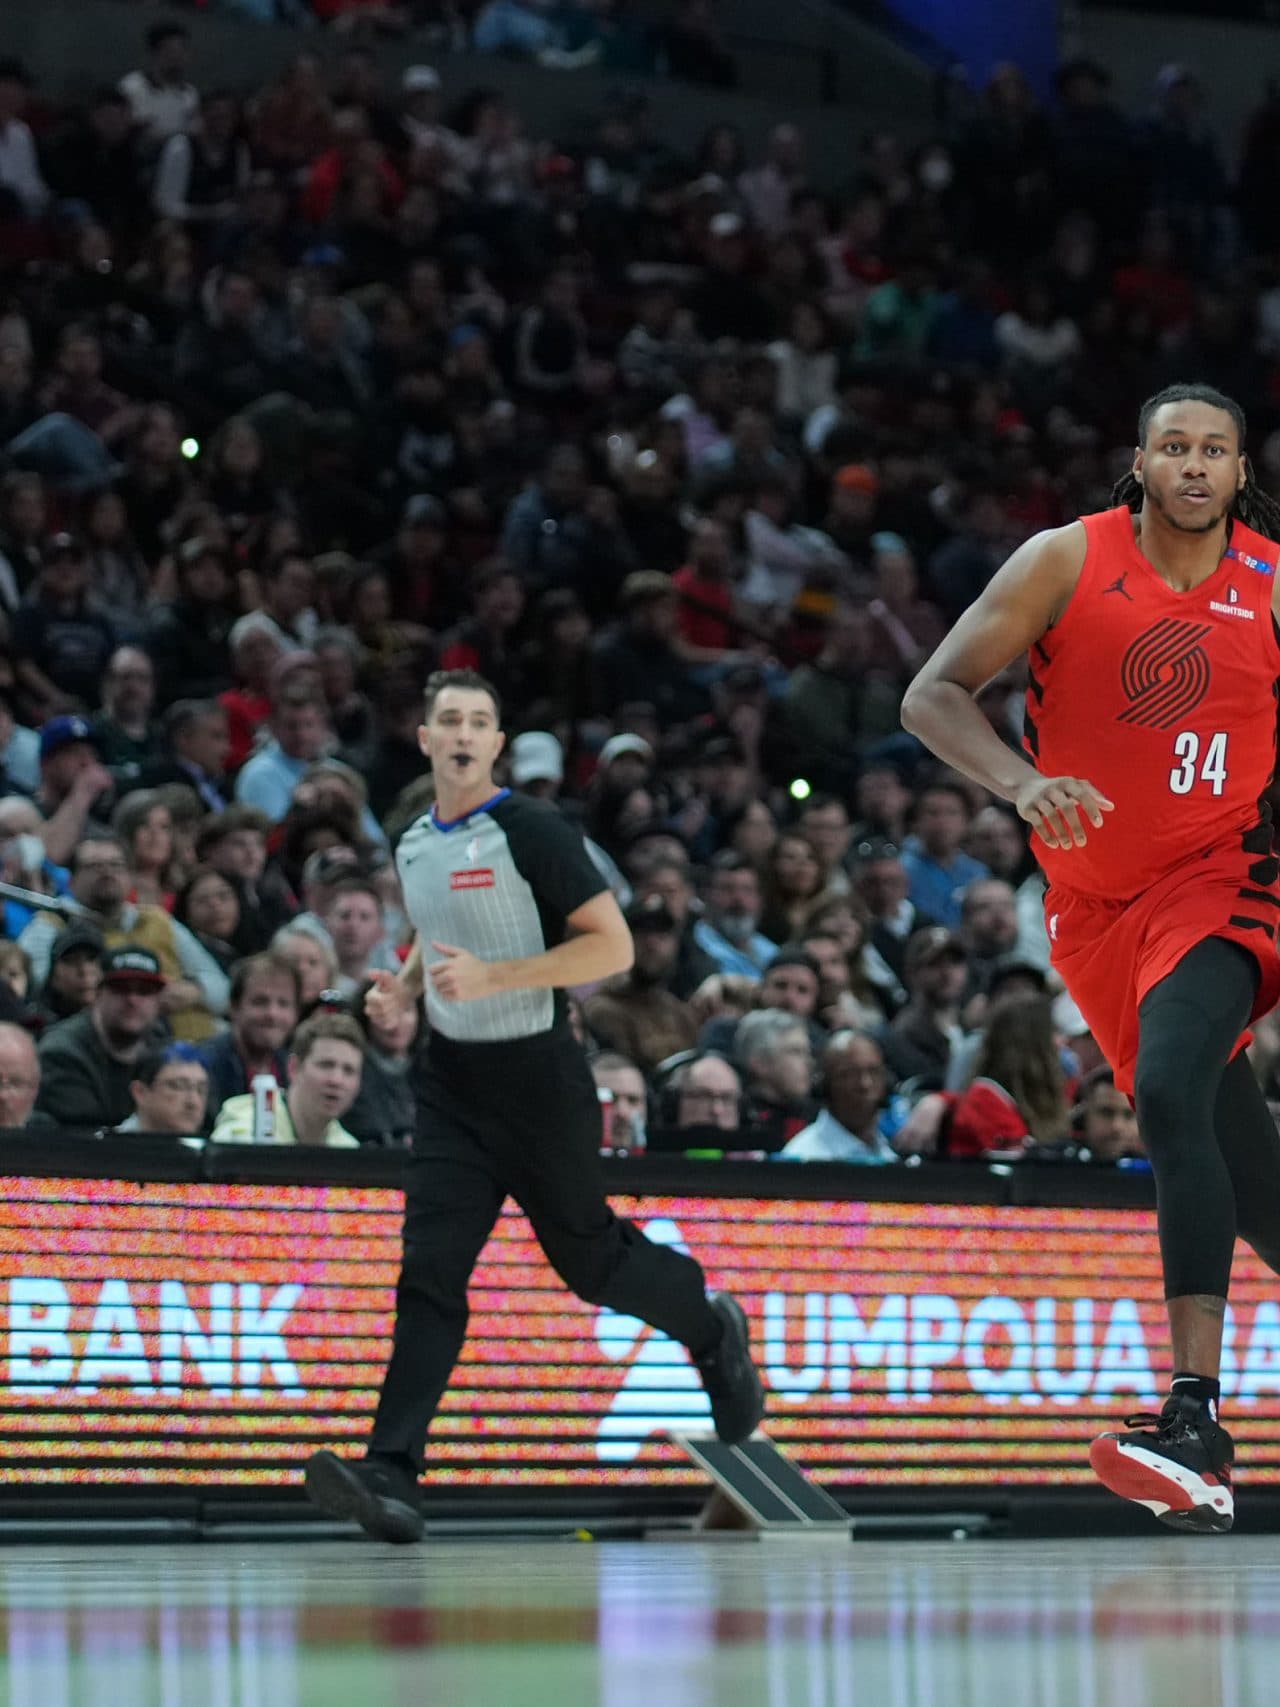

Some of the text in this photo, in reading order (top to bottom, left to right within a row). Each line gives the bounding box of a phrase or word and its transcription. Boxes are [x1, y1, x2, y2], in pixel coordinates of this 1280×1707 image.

[1210, 601, 1255, 619] BRIGHTSIDE
[1169, 731, 1228, 796] 34
[8, 1277, 306, 1397] BANK
[764, 1292, 1160, 1405] UMPQUA
